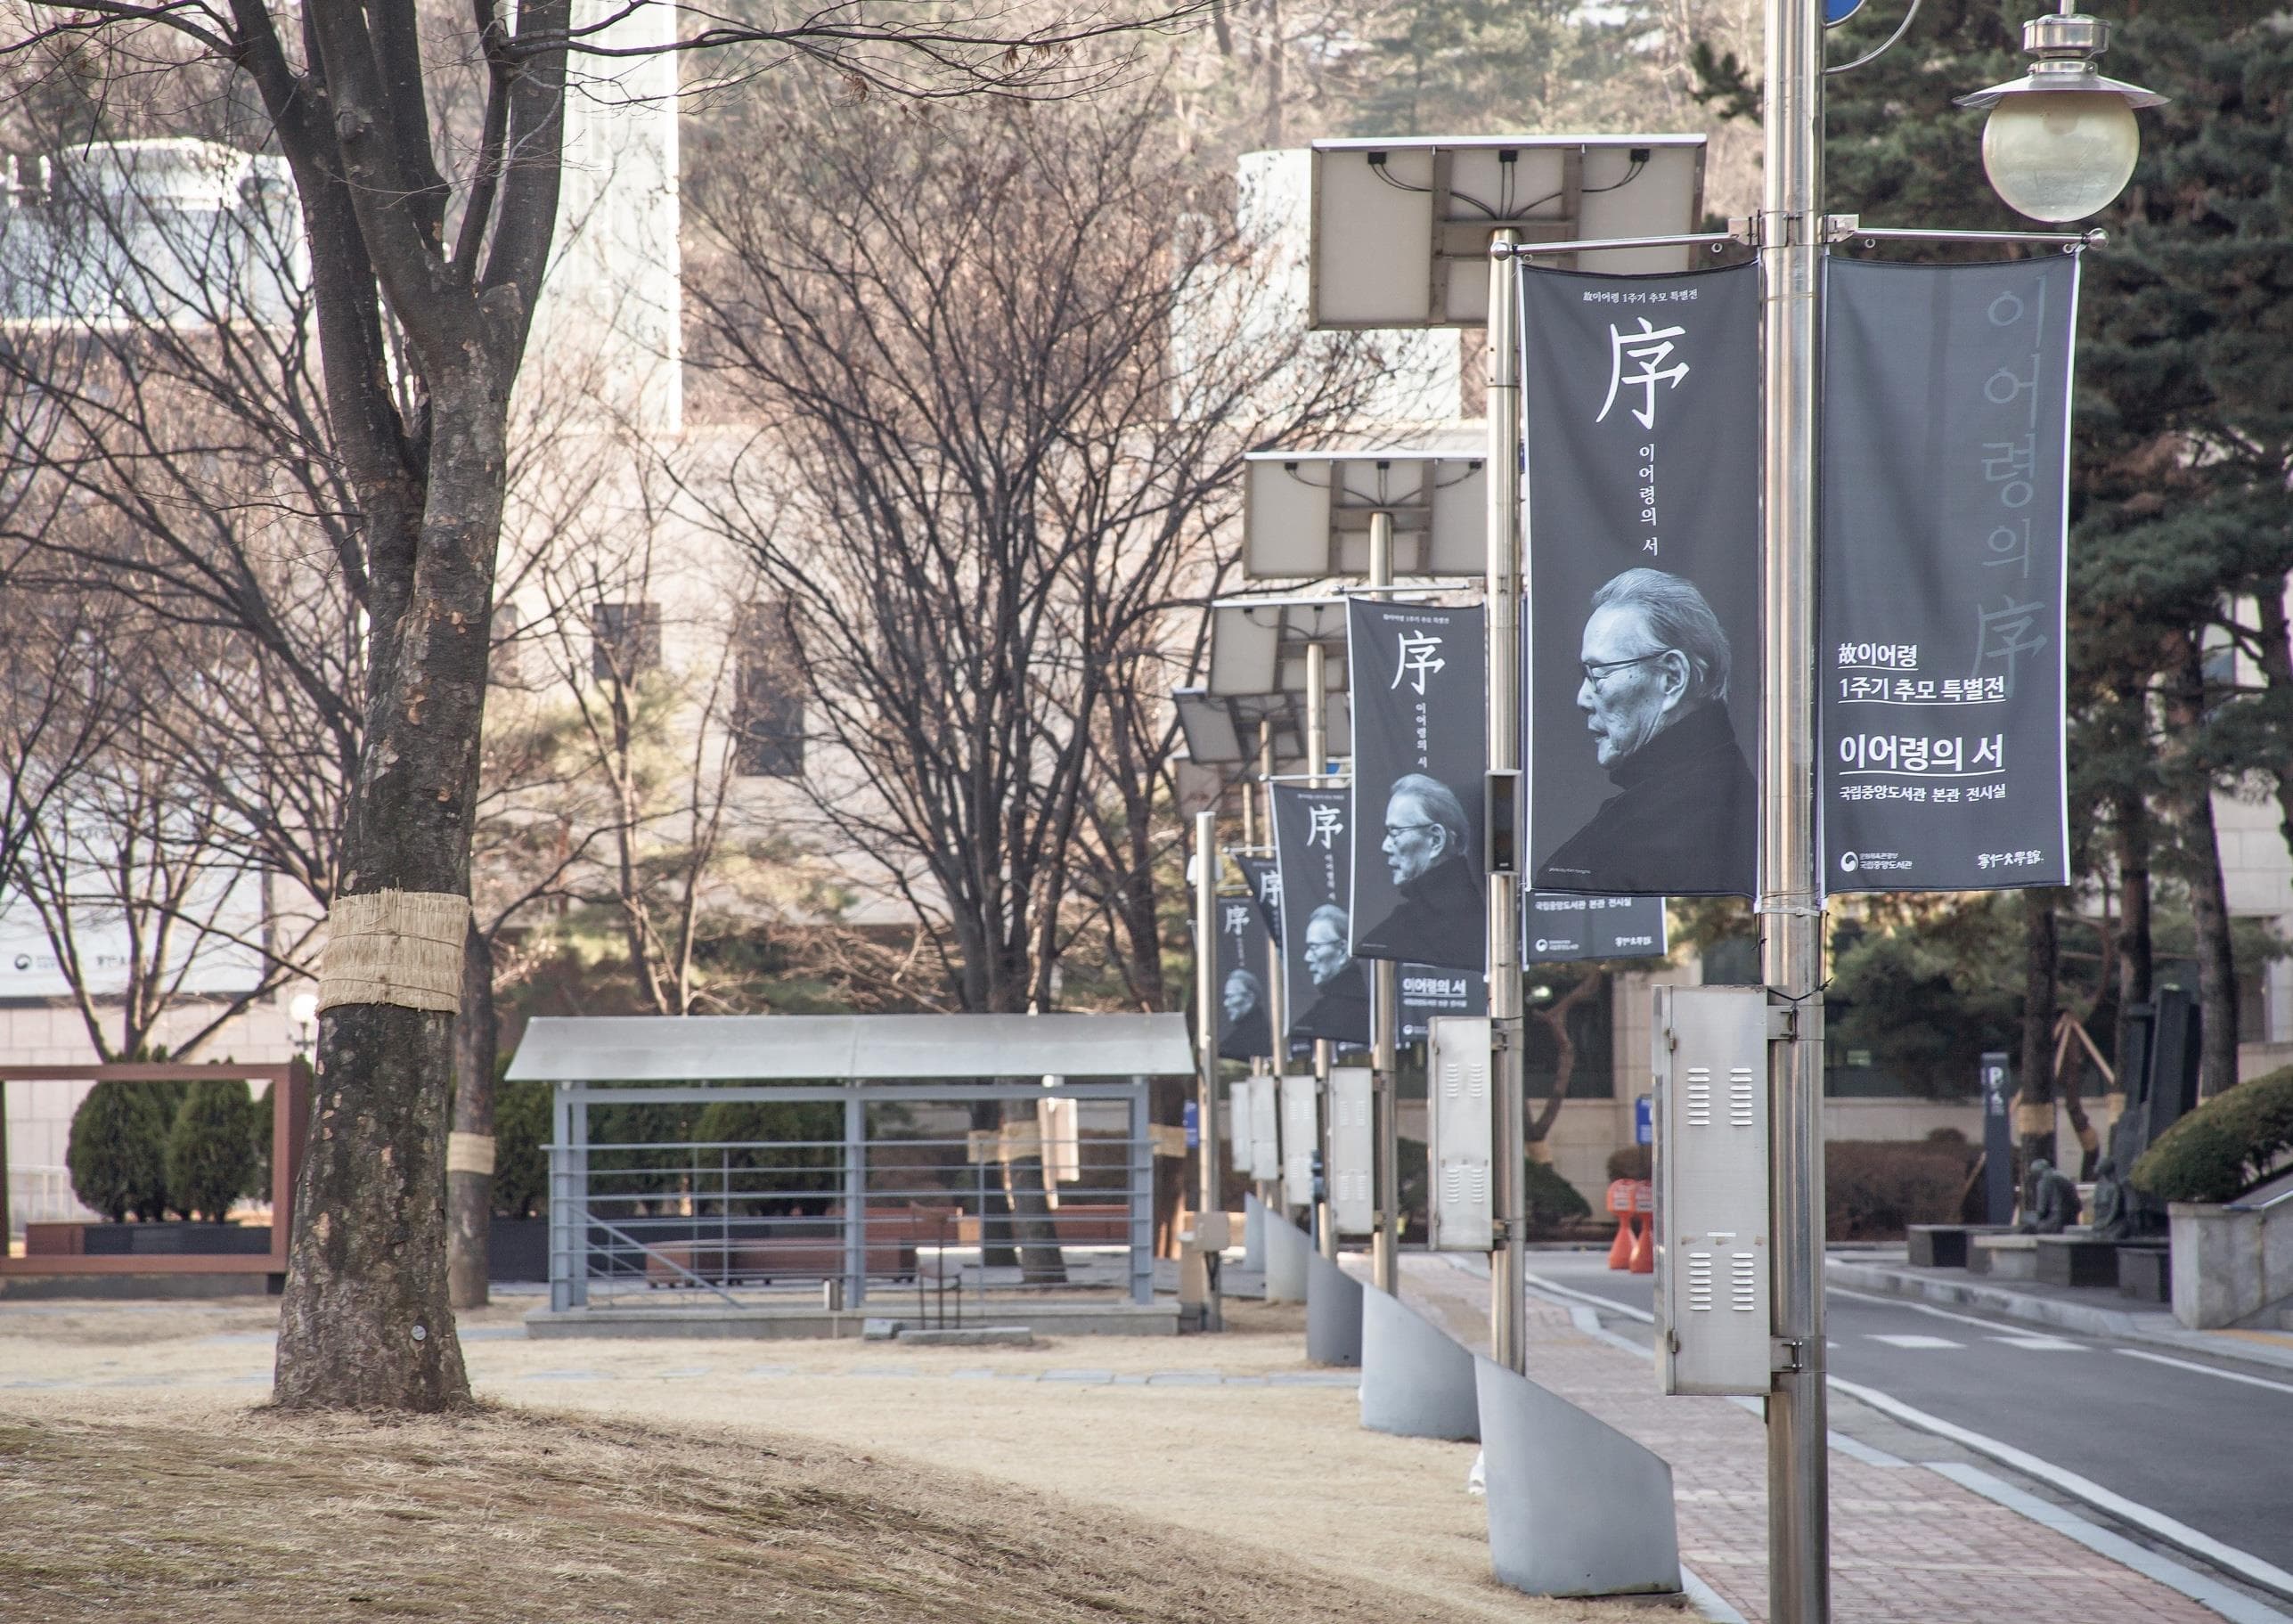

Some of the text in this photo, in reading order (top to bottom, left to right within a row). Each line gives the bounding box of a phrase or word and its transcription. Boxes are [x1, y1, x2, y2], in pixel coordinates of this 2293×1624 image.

[1622, 292, 1646, 304] 1주기
[1649, 291, 1669, 304] 추모
[1669, 288, 1699, 302] 특별전
[1595, 316, 1691, 430] 序
[1638, 443, 1658, 557] 이어령의 서
[1391, 629, 1446, 696] 序
[1838, 641, 1918, 667] 故이어령
[1840, 675, 2005, 701] 1주기 추모 특별전
[1840, 733, 2003, 771] 이어령의 서
[1839, 783, 2006, 803] 국립중앙도서관 본관 전시실
[1306, 804, 1344, 850] 序
